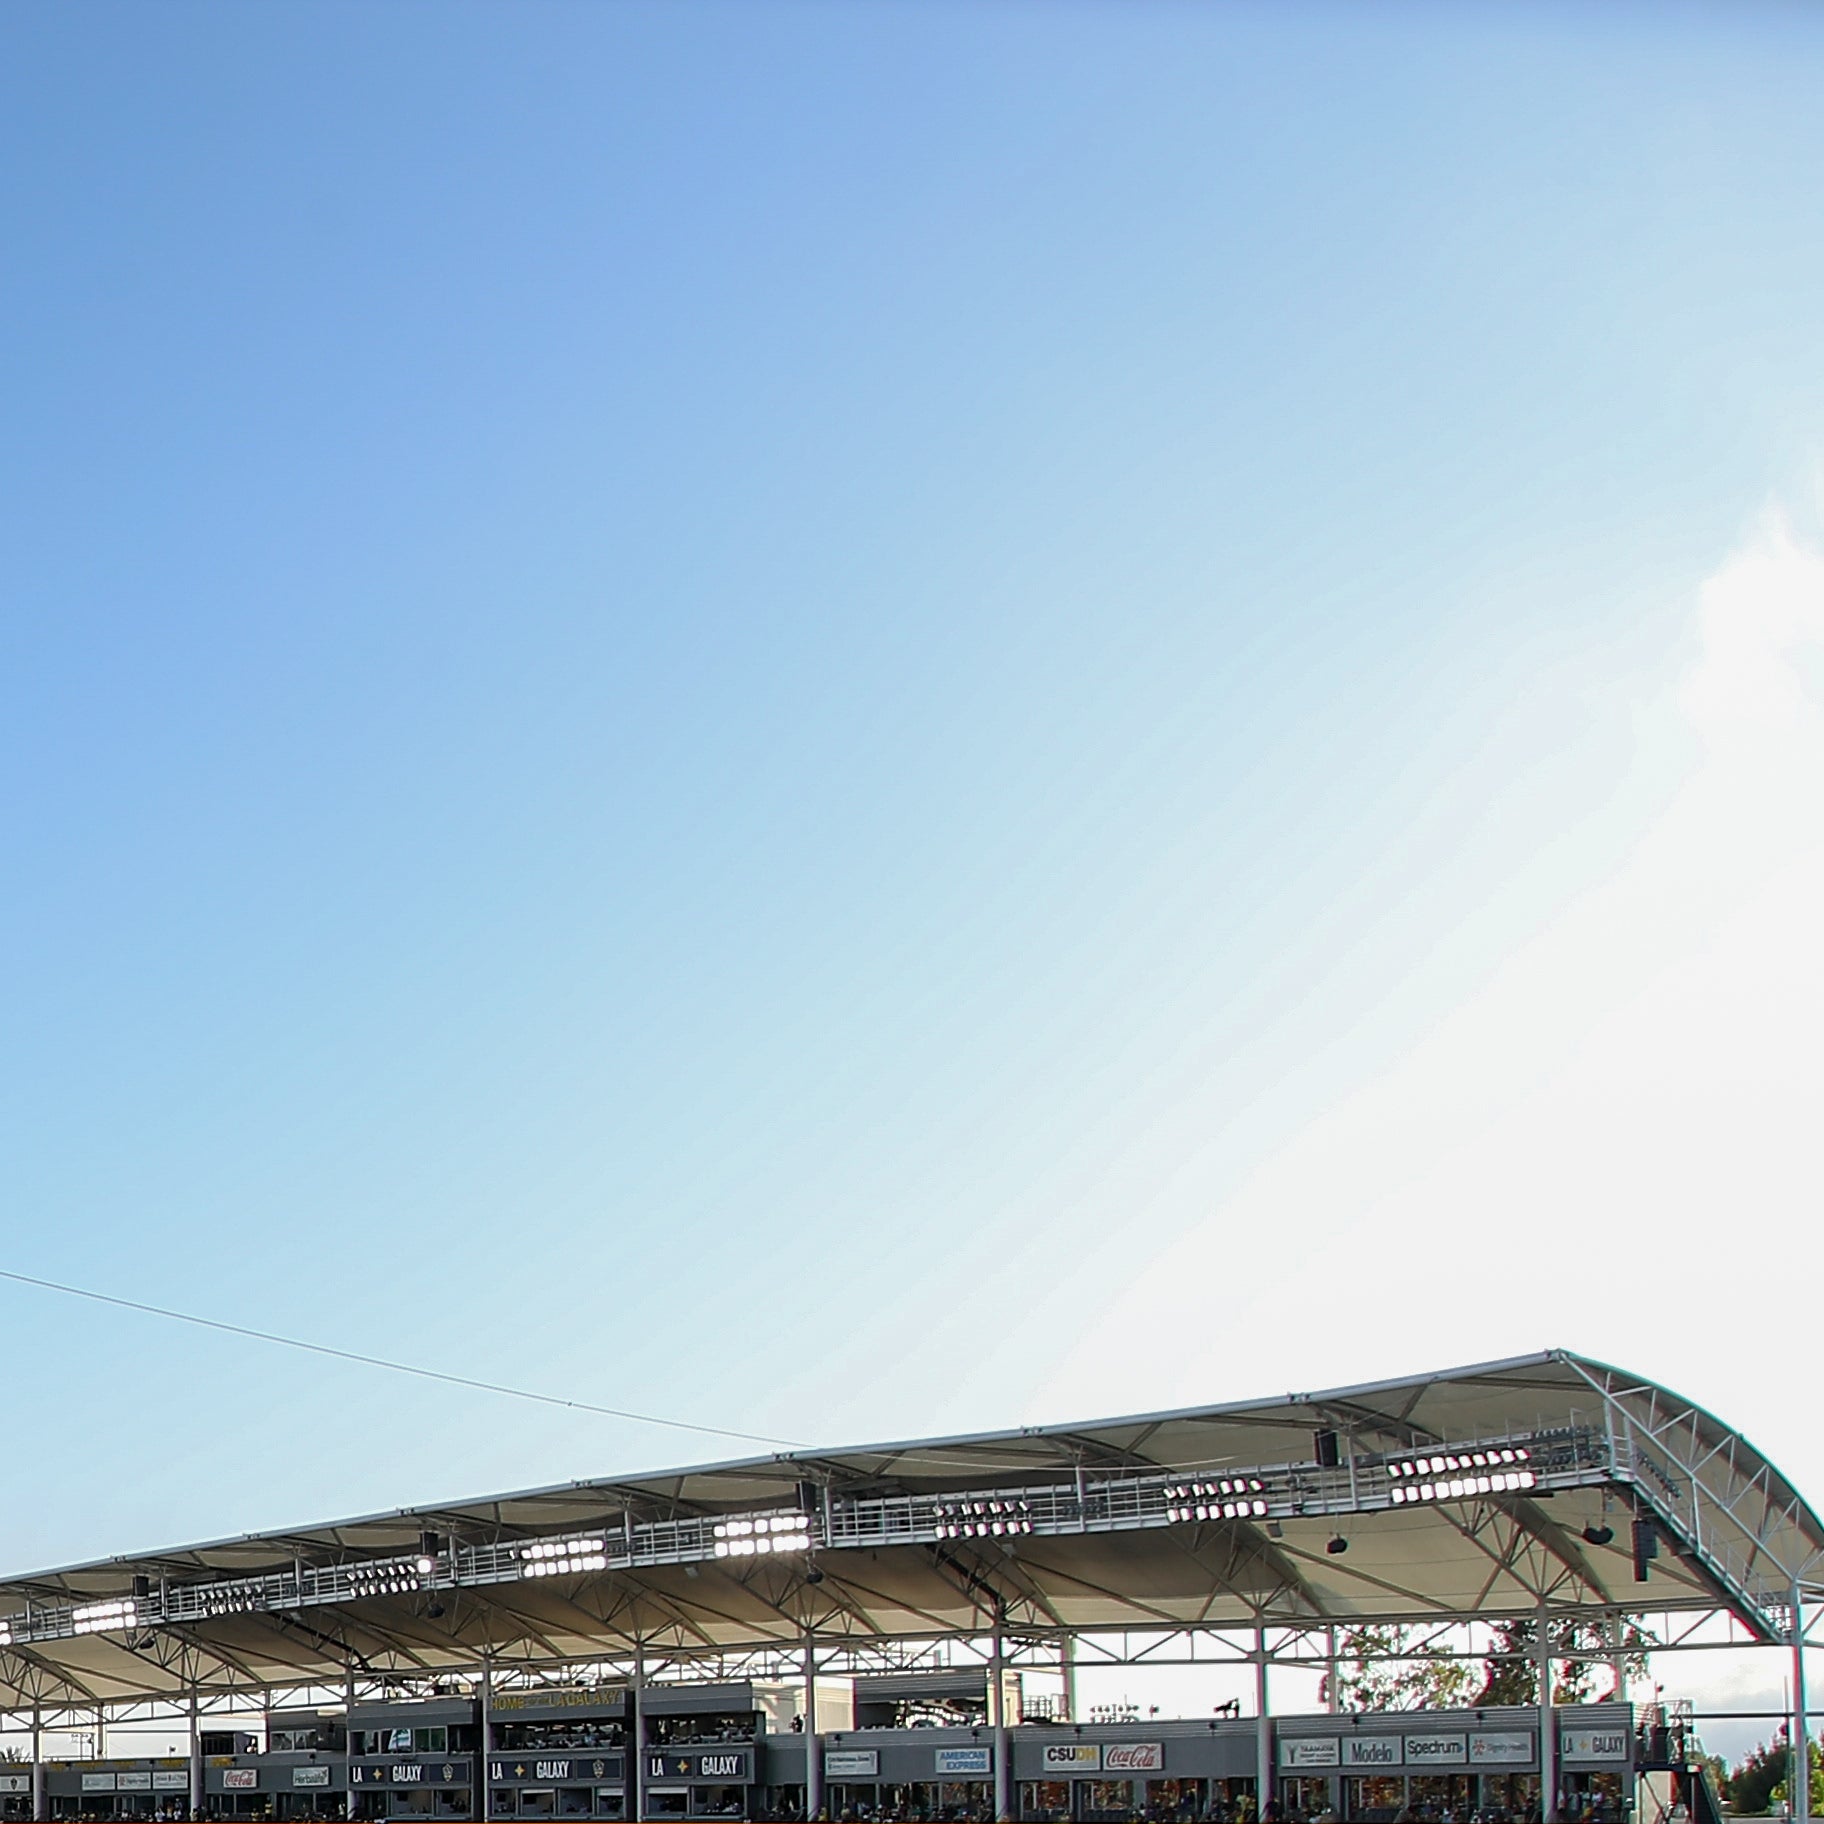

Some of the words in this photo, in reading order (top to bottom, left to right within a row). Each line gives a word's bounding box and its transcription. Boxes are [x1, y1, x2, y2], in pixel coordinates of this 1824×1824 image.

[492, 1696, 524, 1710] HOME
[1351, 1743, 1392, 1762] Modelo
[1407, 1741, 1459, 1757] Spectrum
[1563, 1737, 1573, 1753] LA
[1591, 1736, 1624, 1753] GALAXY
[940, 1751, 986, 1759] AMERICAN
[1047, 1748, 1097, 1762] CSUDH
[1106, 1747, 1155, 1768] Coca-Cola
[353, 1766, 362, 1782] LA
[392, 1765, 421, 1782] GALAXY
[492, 1762, 502, 1780] LA
[537, 1760, 569, 1779] GALAXY
[652, 1758, 663, 1776] LA
[702, 1756, 738, 1775] GALAXY
[946, 1761, 986, 1770] EXPRESS
